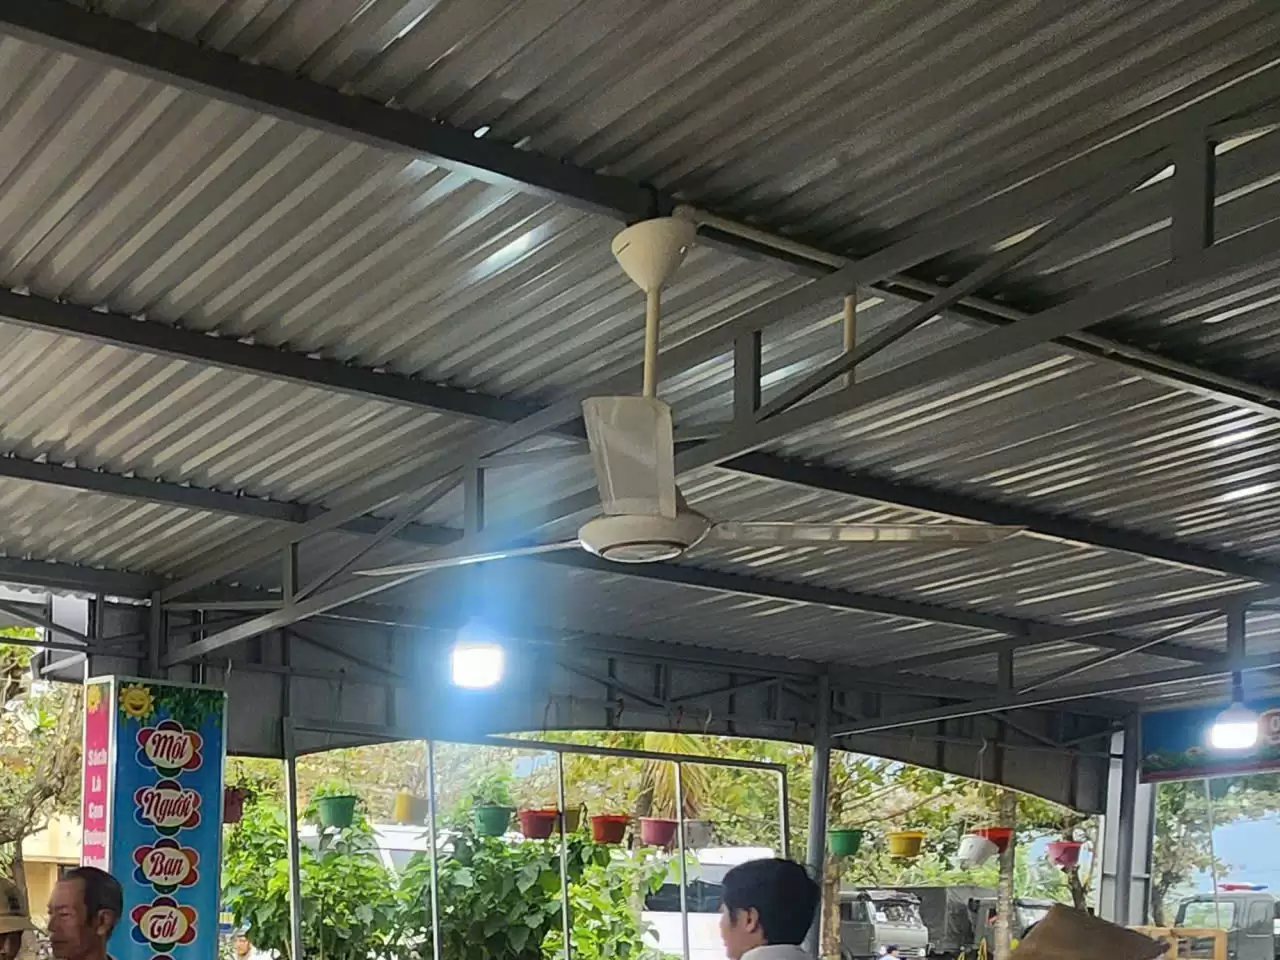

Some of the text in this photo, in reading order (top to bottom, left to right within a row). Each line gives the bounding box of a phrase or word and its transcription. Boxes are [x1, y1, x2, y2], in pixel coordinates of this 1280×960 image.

[152, 733, 188, 764] Một
[143, 791, 193, 823] Người
[149, 851, 184, 881] Bạn
[150, 911, 178, 938] Tốt
